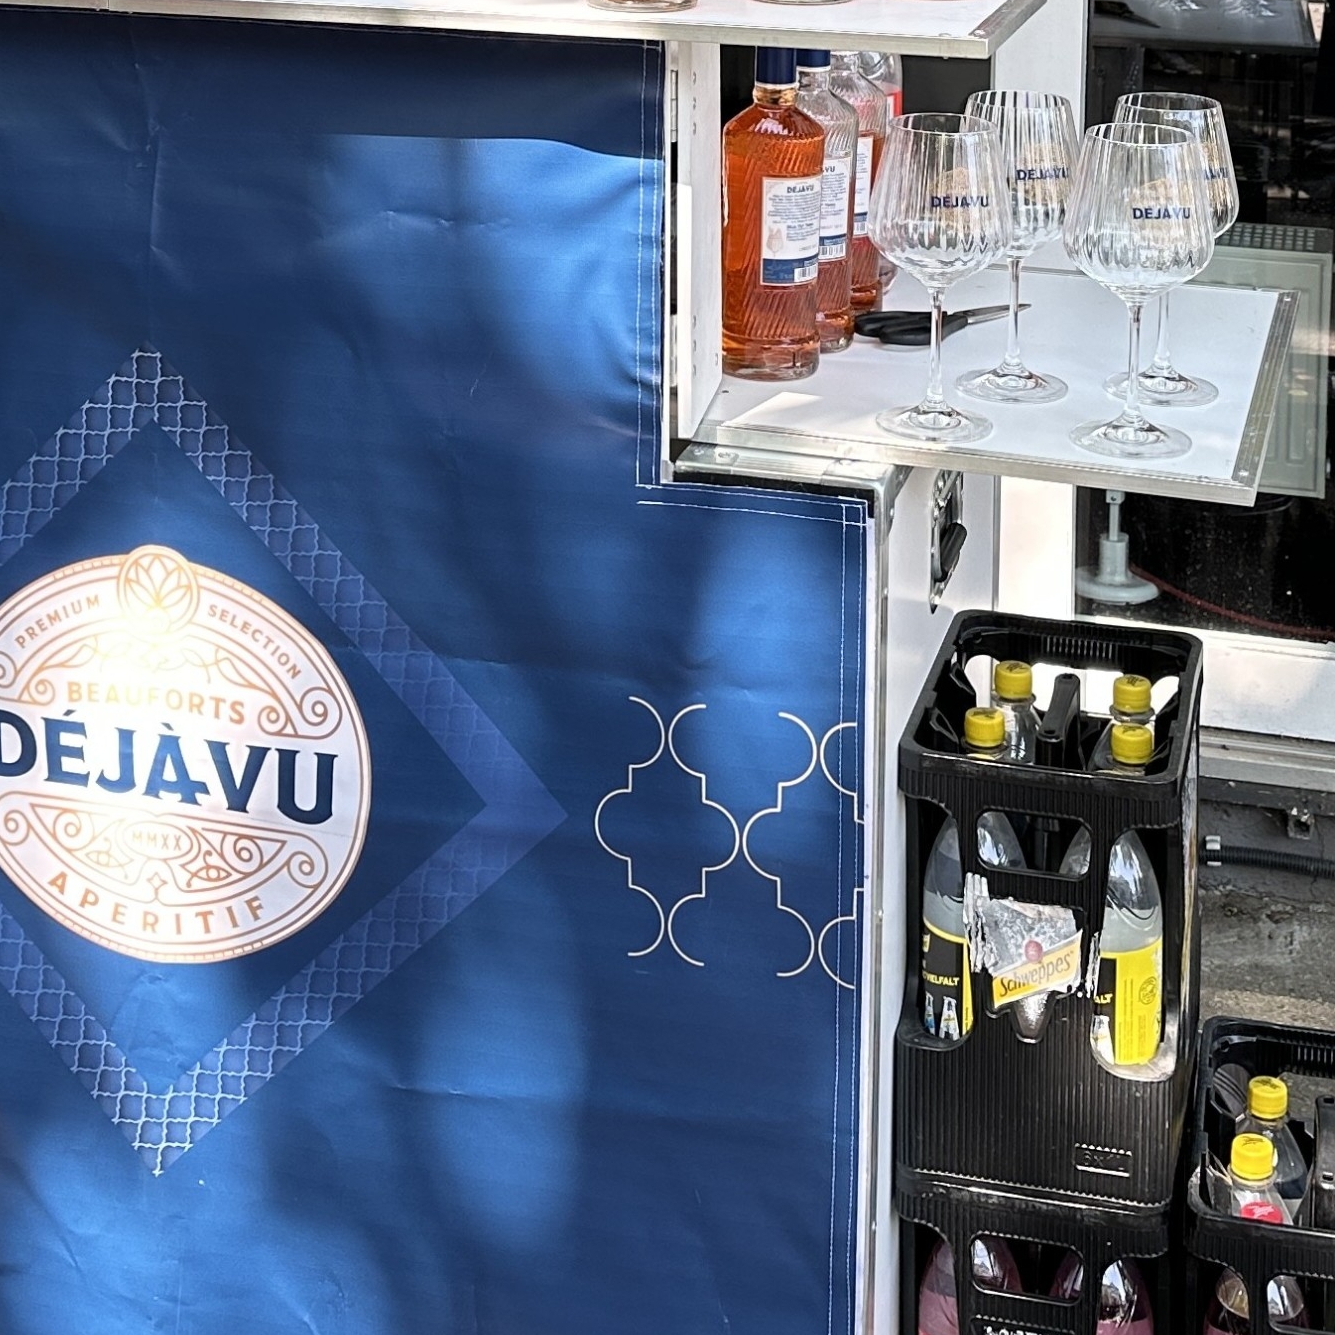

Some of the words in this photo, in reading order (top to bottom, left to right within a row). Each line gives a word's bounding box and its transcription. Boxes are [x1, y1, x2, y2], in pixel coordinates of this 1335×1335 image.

[14, 594, 100, 649] PREMIUM
[207, 603, 303, 680] SELECTION
[67, 680, 246, 726] BEAUFORTS
[131, 829, 183, 852] MMXX
[48, 871, 265, 937] APERITIF
[999, 952, 1072, 998] Schweppes
